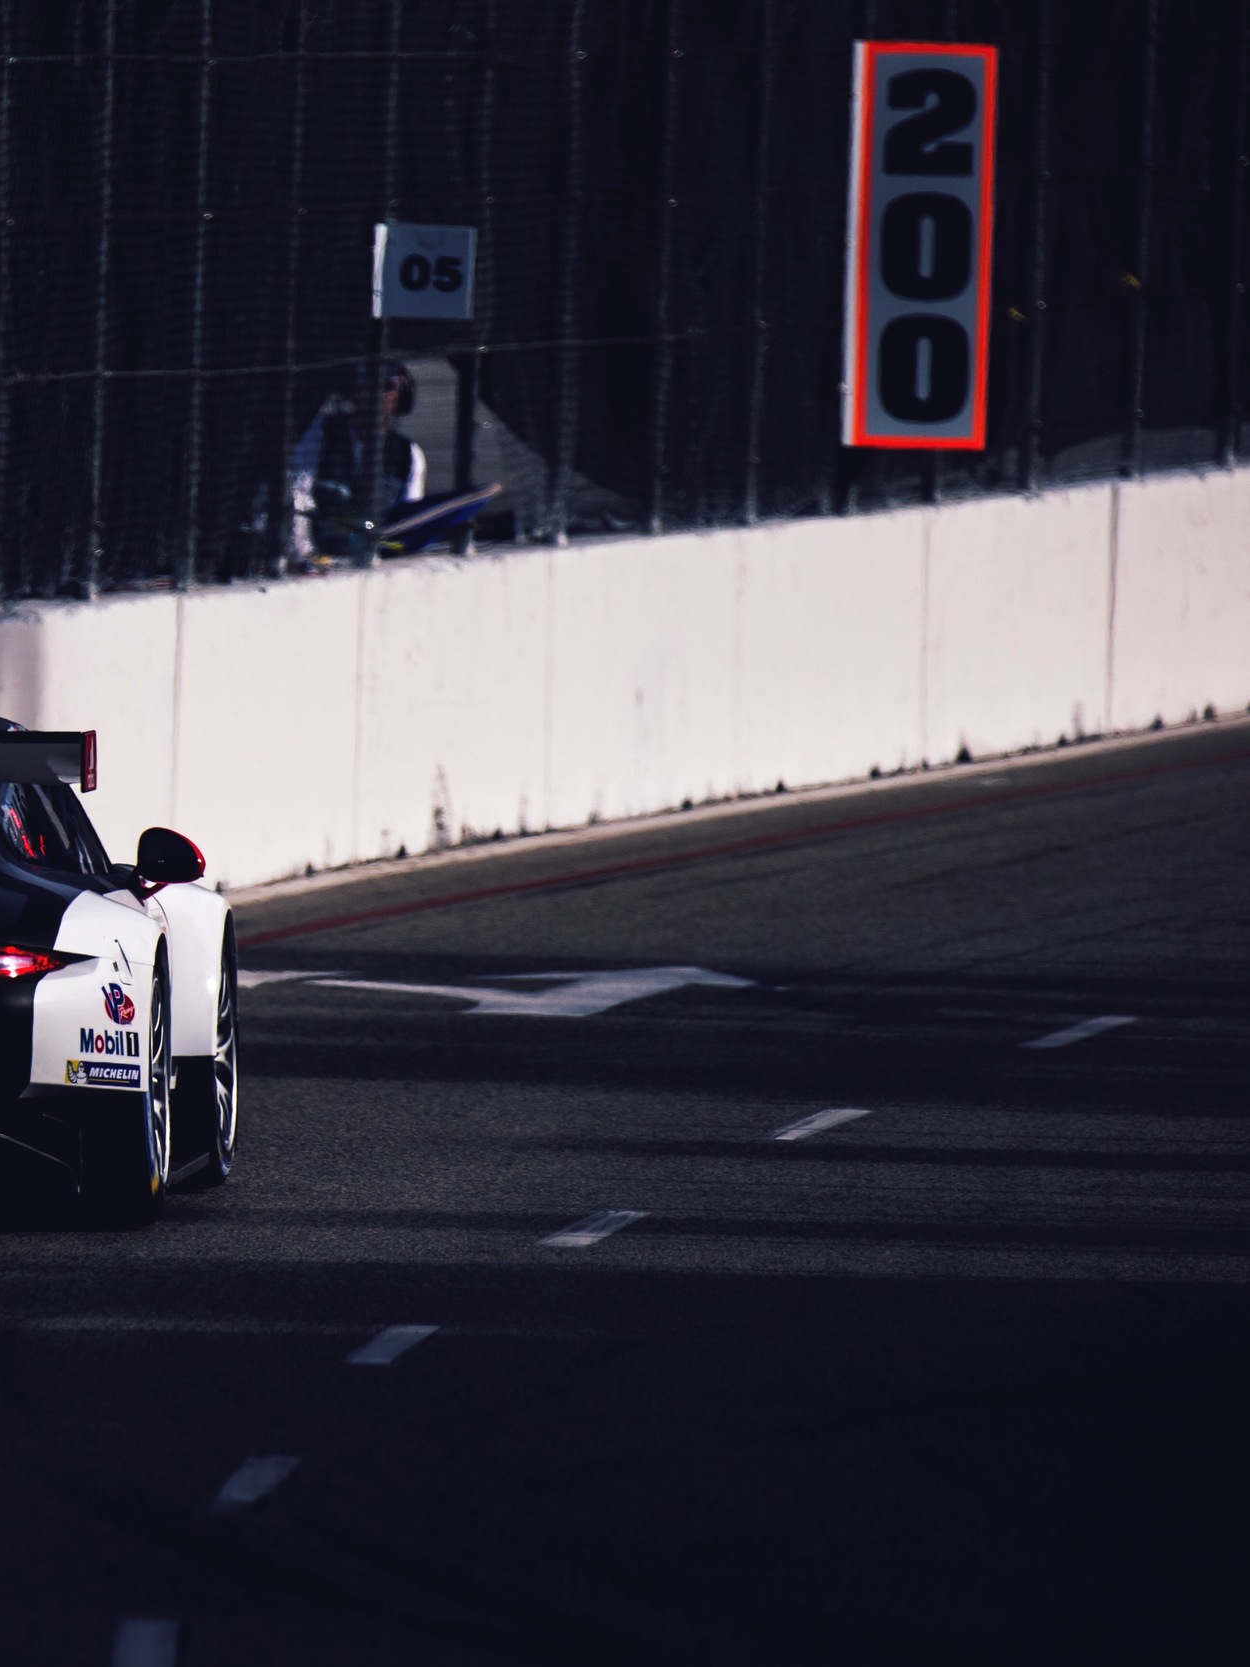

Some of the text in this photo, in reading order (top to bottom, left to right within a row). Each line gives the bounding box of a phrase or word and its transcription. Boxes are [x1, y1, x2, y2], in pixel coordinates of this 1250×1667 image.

[881, 67, 977, 423] 200
[400, 253, 463, 292] 05
[80, 1028, 124, 1056] Mobil
[89, 1067, 139, 1080] MICHELIN
